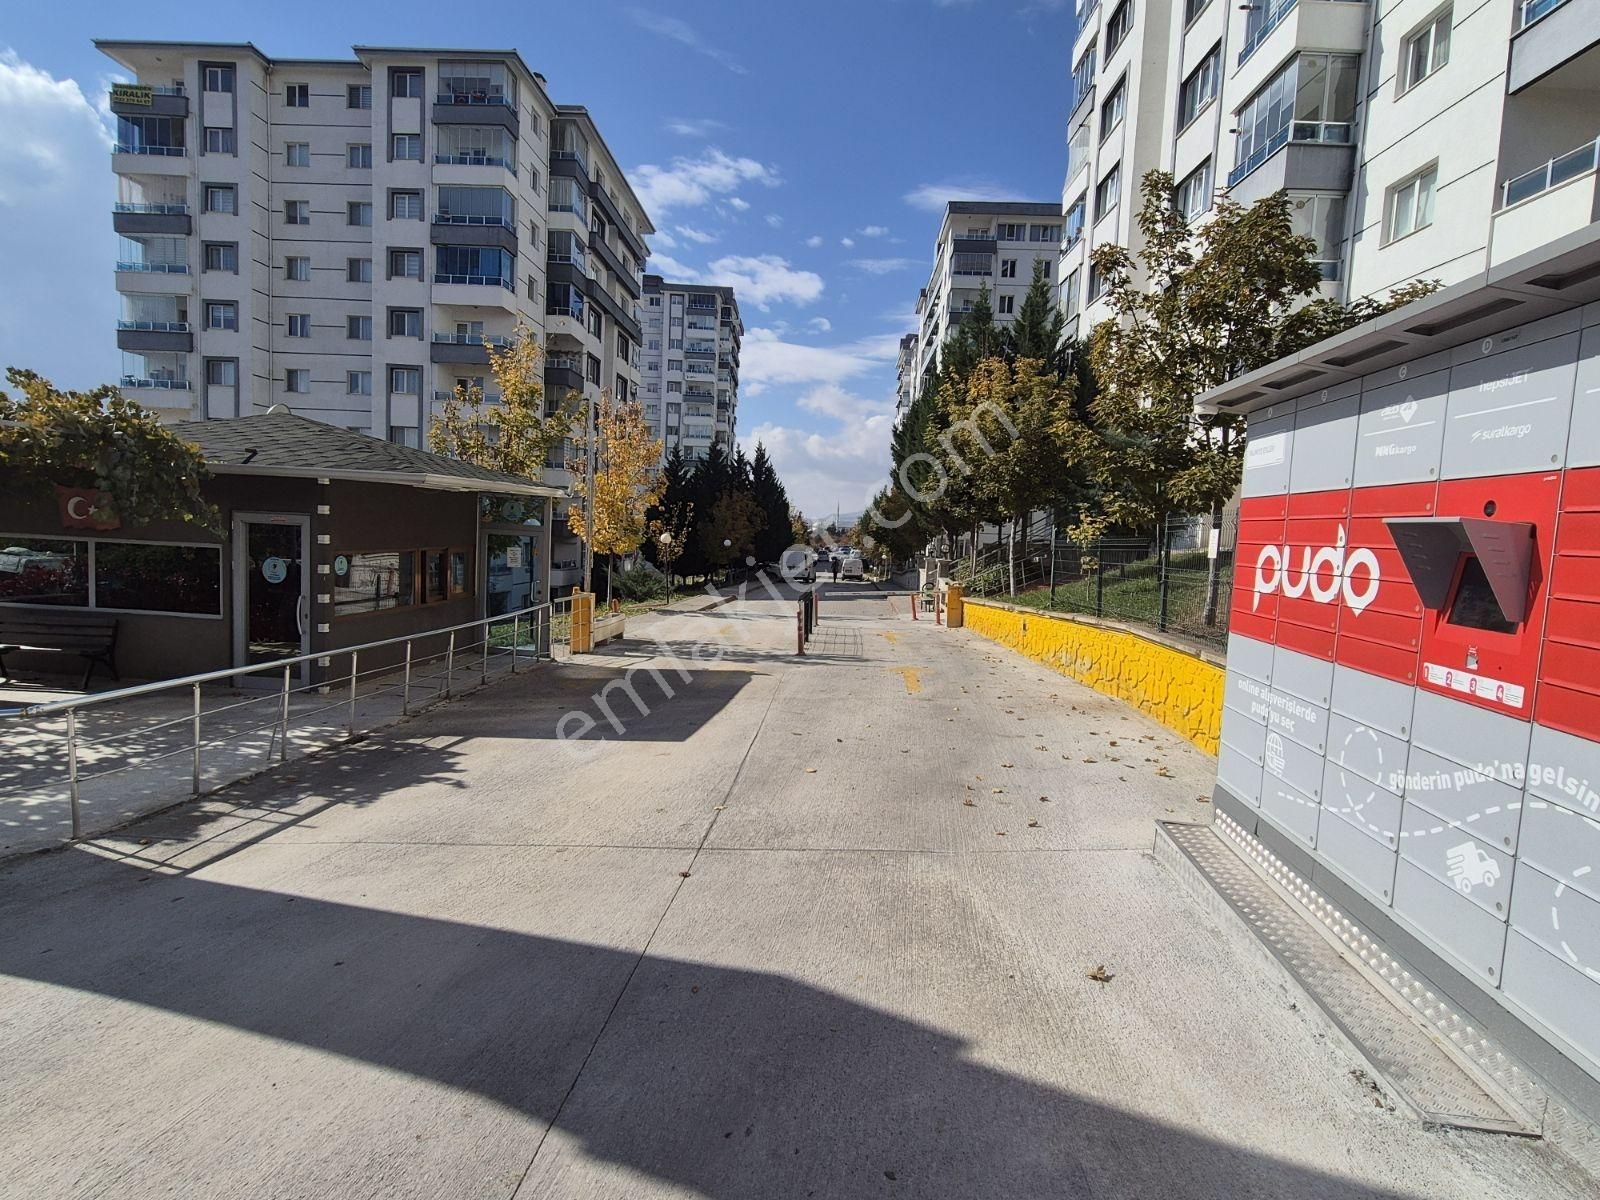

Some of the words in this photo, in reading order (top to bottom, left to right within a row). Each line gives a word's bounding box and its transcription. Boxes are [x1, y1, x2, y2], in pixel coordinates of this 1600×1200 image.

[1253, 523, 1380, 617] pudo
[1238, 679, 1260, 697] online
[1388, 769, 1451, 791] gönderin
[1454, 760, 1526, 792] pudo'na
[1529, 763, 1600, 813] gelsin
